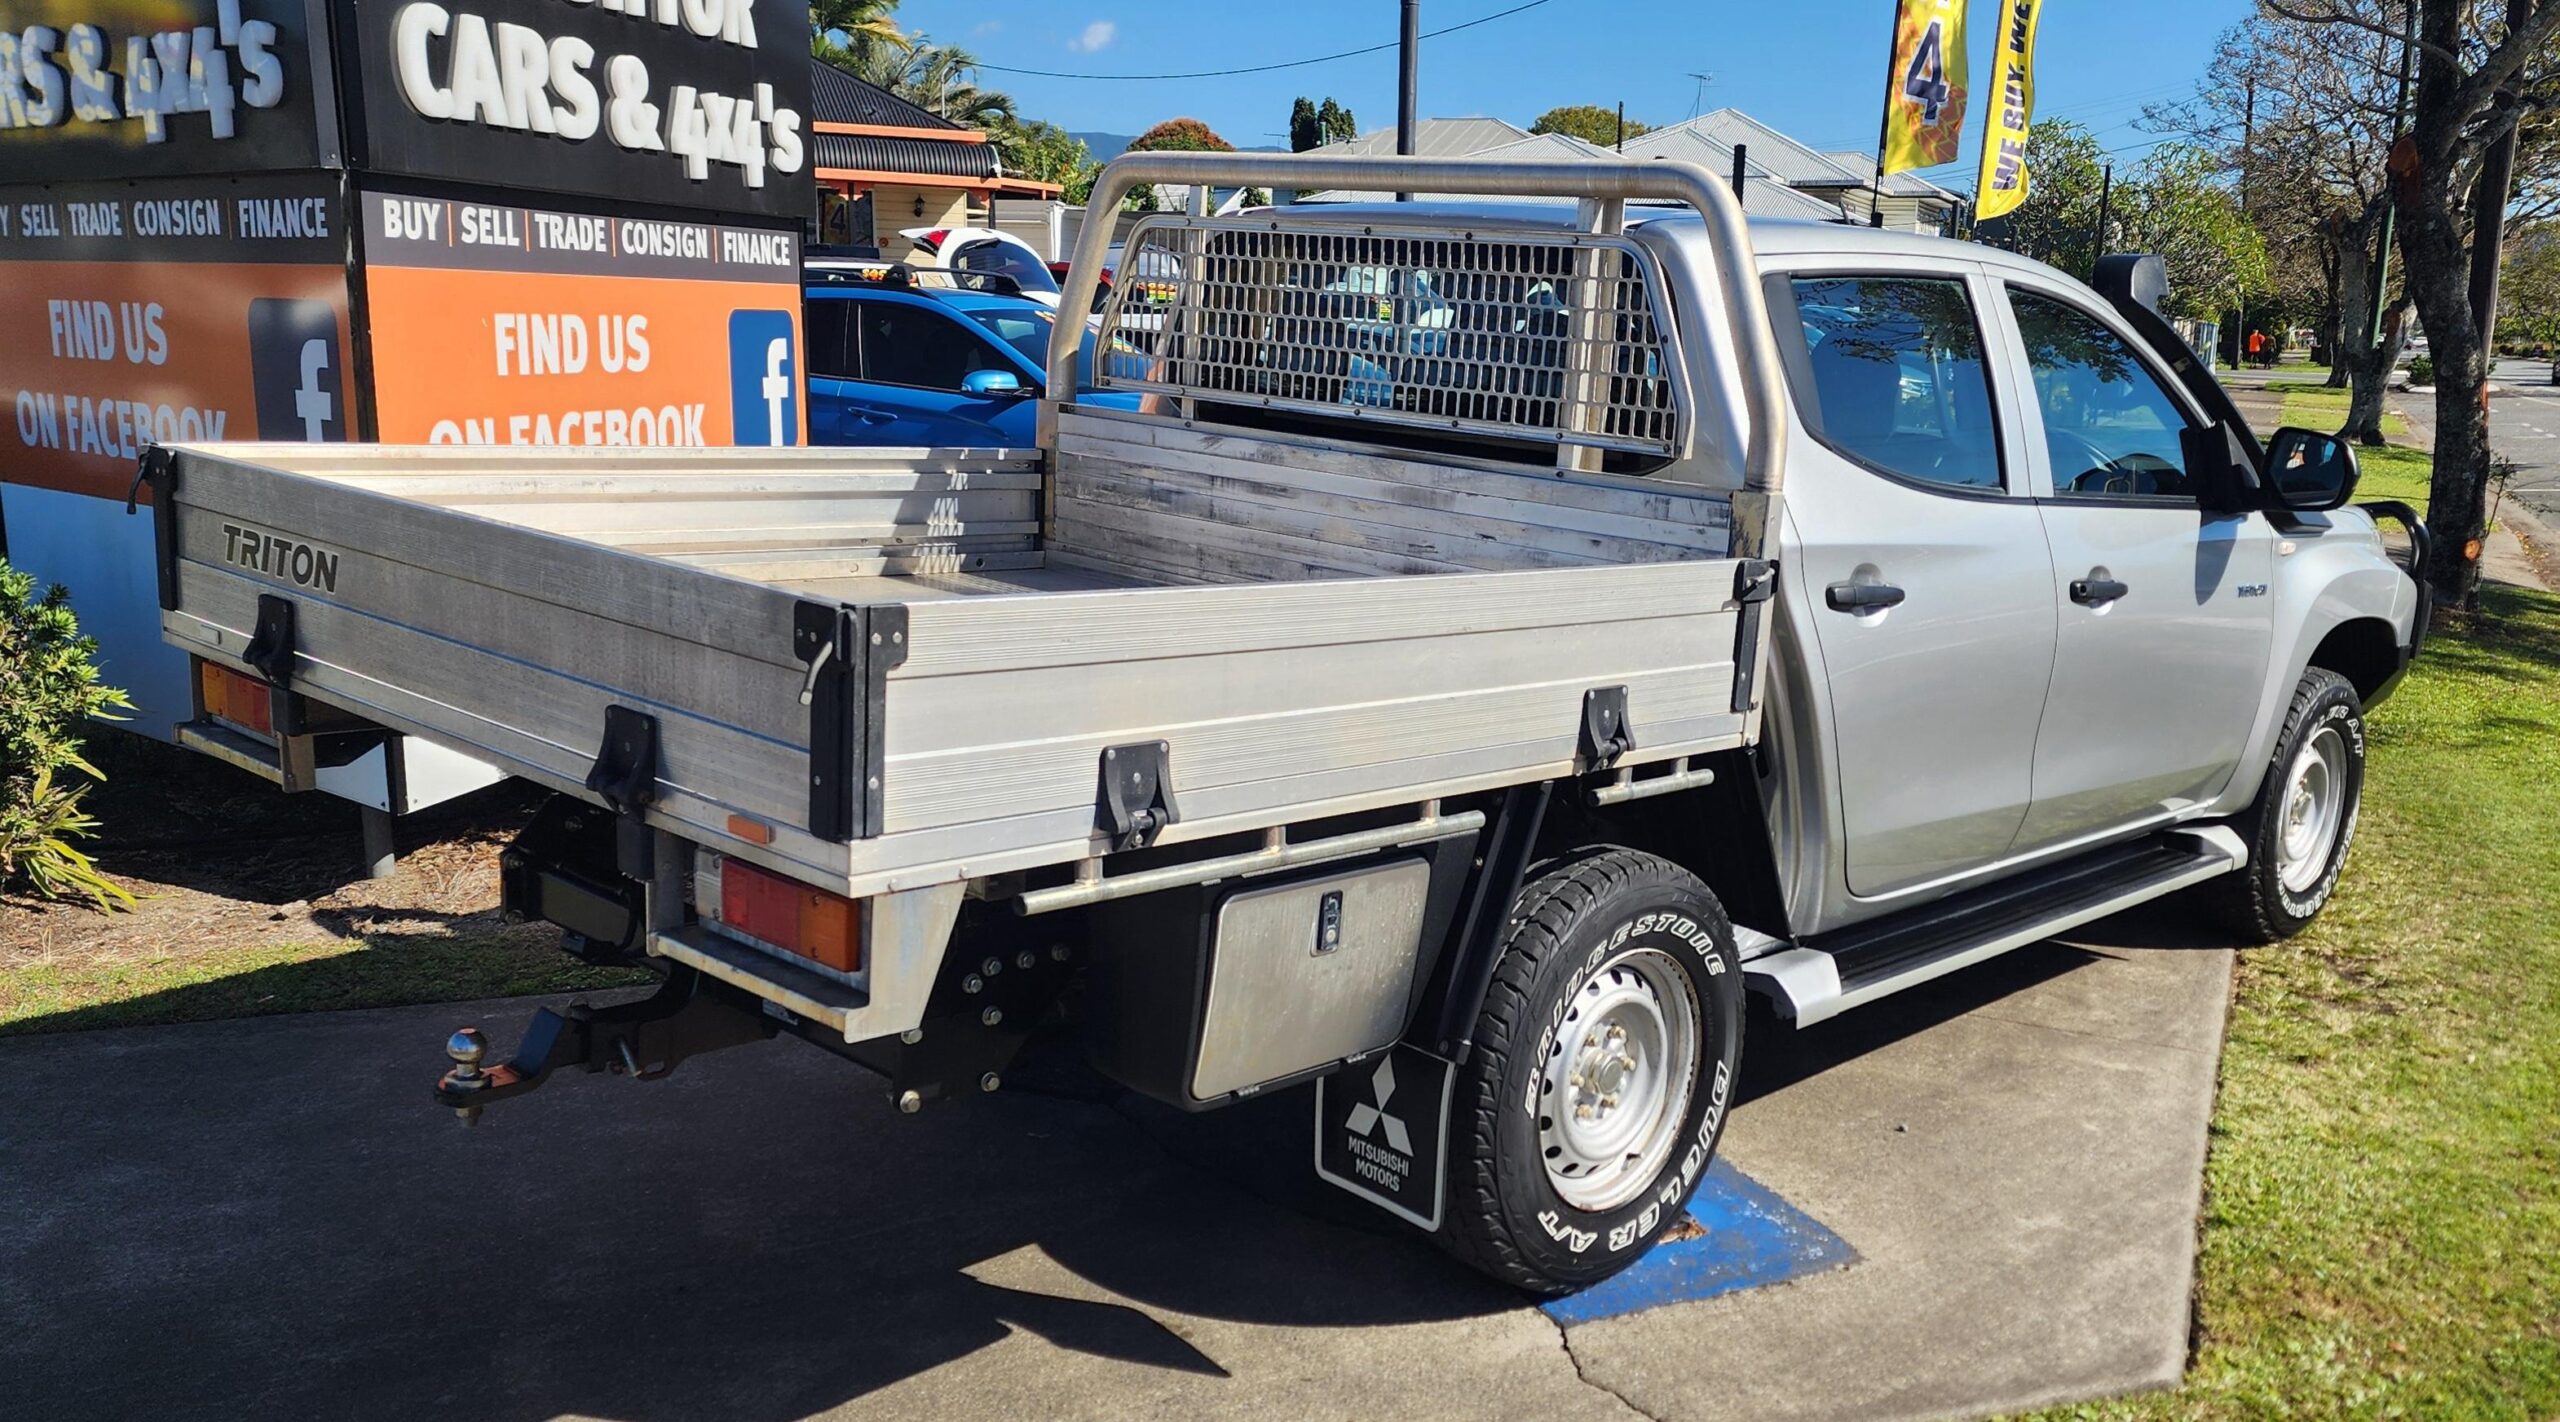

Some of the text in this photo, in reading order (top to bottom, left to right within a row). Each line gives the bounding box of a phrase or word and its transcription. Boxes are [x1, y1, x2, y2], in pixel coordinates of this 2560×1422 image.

[67, 22, 122, 123] &
[396, 1, 600, 140] CARS
[609, 54, 665, 151] &
[1906, 20, 1950, 121] 4
[1992, 138, 2025, 191] WE
[20, 203, 60, 238] SELL
[67, 201, 122, 237] TRADE
[133, 198, 221, 237] CONSIGN
[237, 198, 328, 238] FINANCE
[383, 198, 791, 266] BUY SELL TRADE CONSIGN FINANCE
[48, 299, 168, 365] FIND US
[493, 313, 650, 376] FIND US
[16, 390, 60, 448] ON
[222, 522, 339, 595] TRITON
[1525, 913, 1726, 1119] BRIDGESTONE
[1348, 1135, 1409, 1178] MITSUBISHI
[1356, 1157, 1400, 1192] MOTORS
[1538, 1060, 1730, 1252] DUELER A/T
